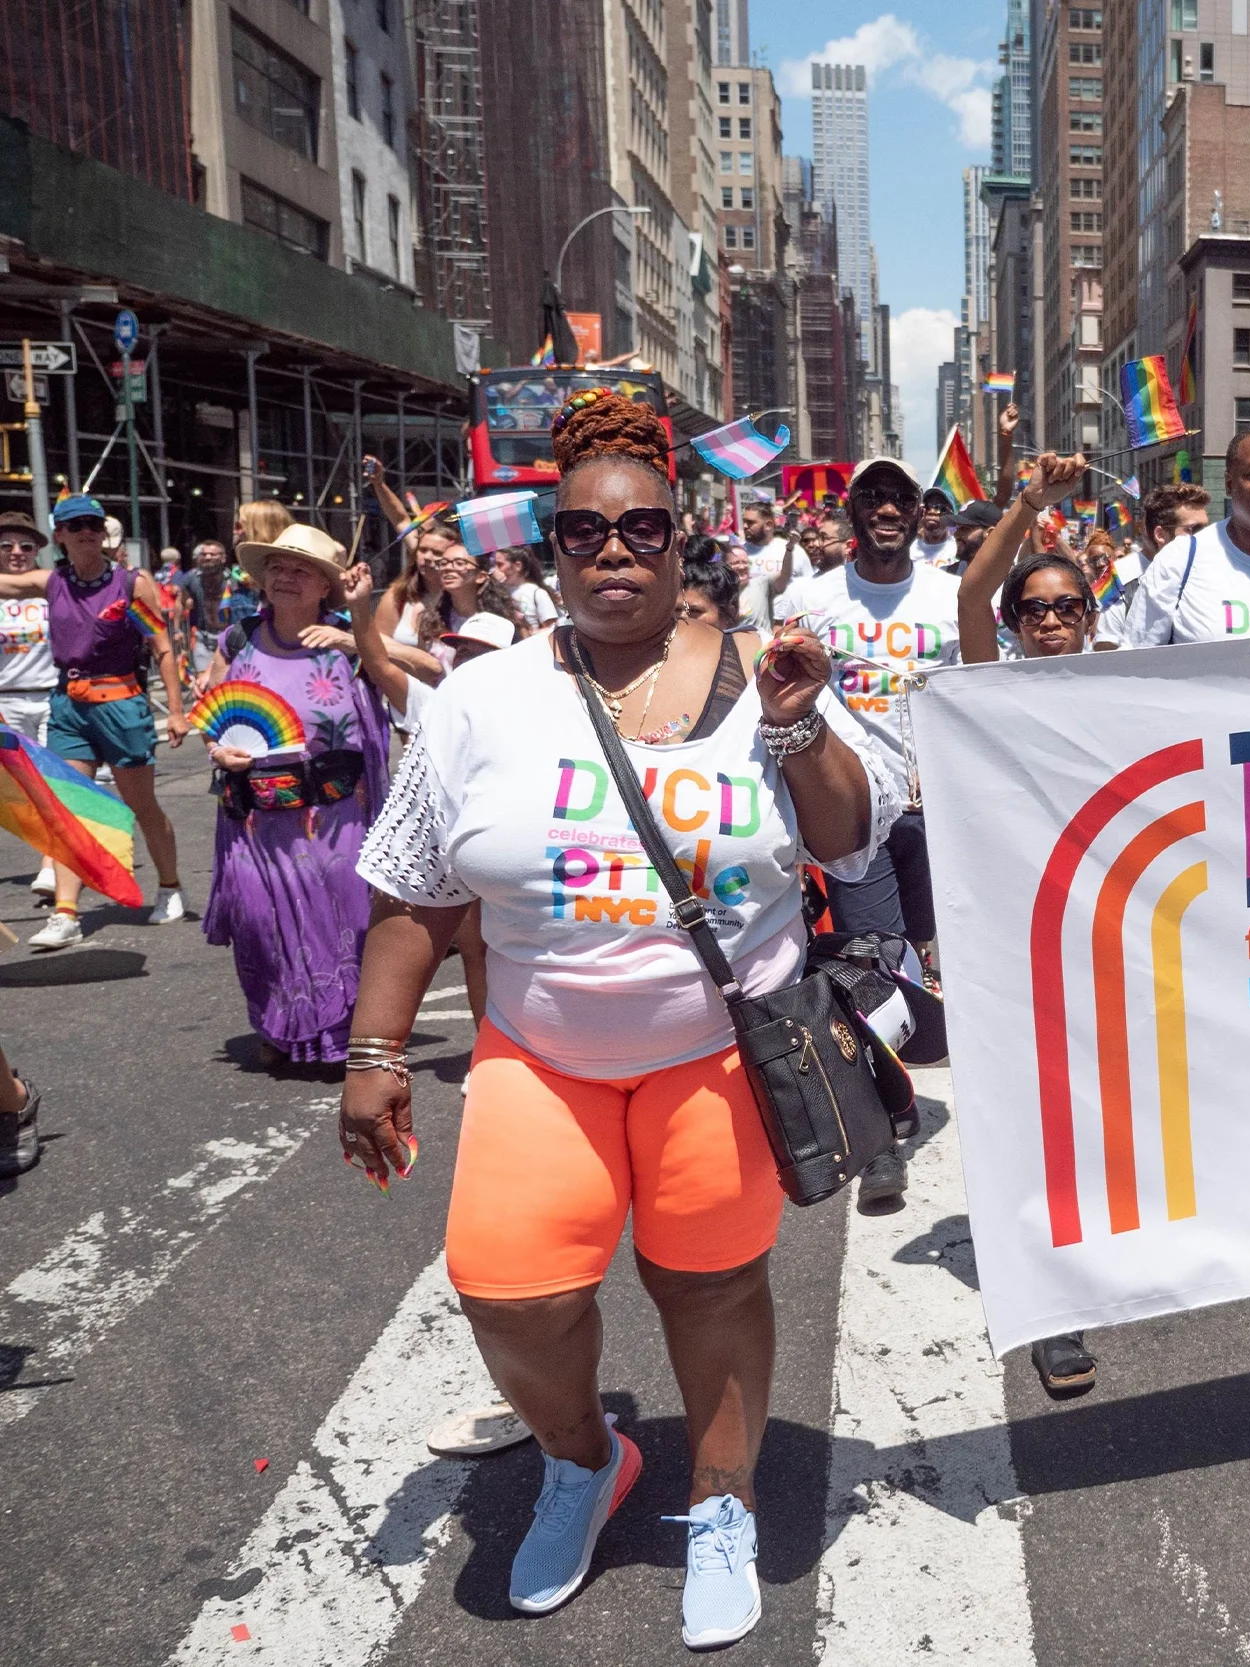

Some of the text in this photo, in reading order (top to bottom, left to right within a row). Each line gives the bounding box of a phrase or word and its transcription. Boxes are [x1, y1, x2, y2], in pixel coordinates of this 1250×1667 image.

[35, 353, 59, 361] WAY
[828, 622, 942, 660] DYCD
[847, 696, 890, 713] NYC
[545, 839, 751, 919] pride
[573, 895, 658, 926] NYC
